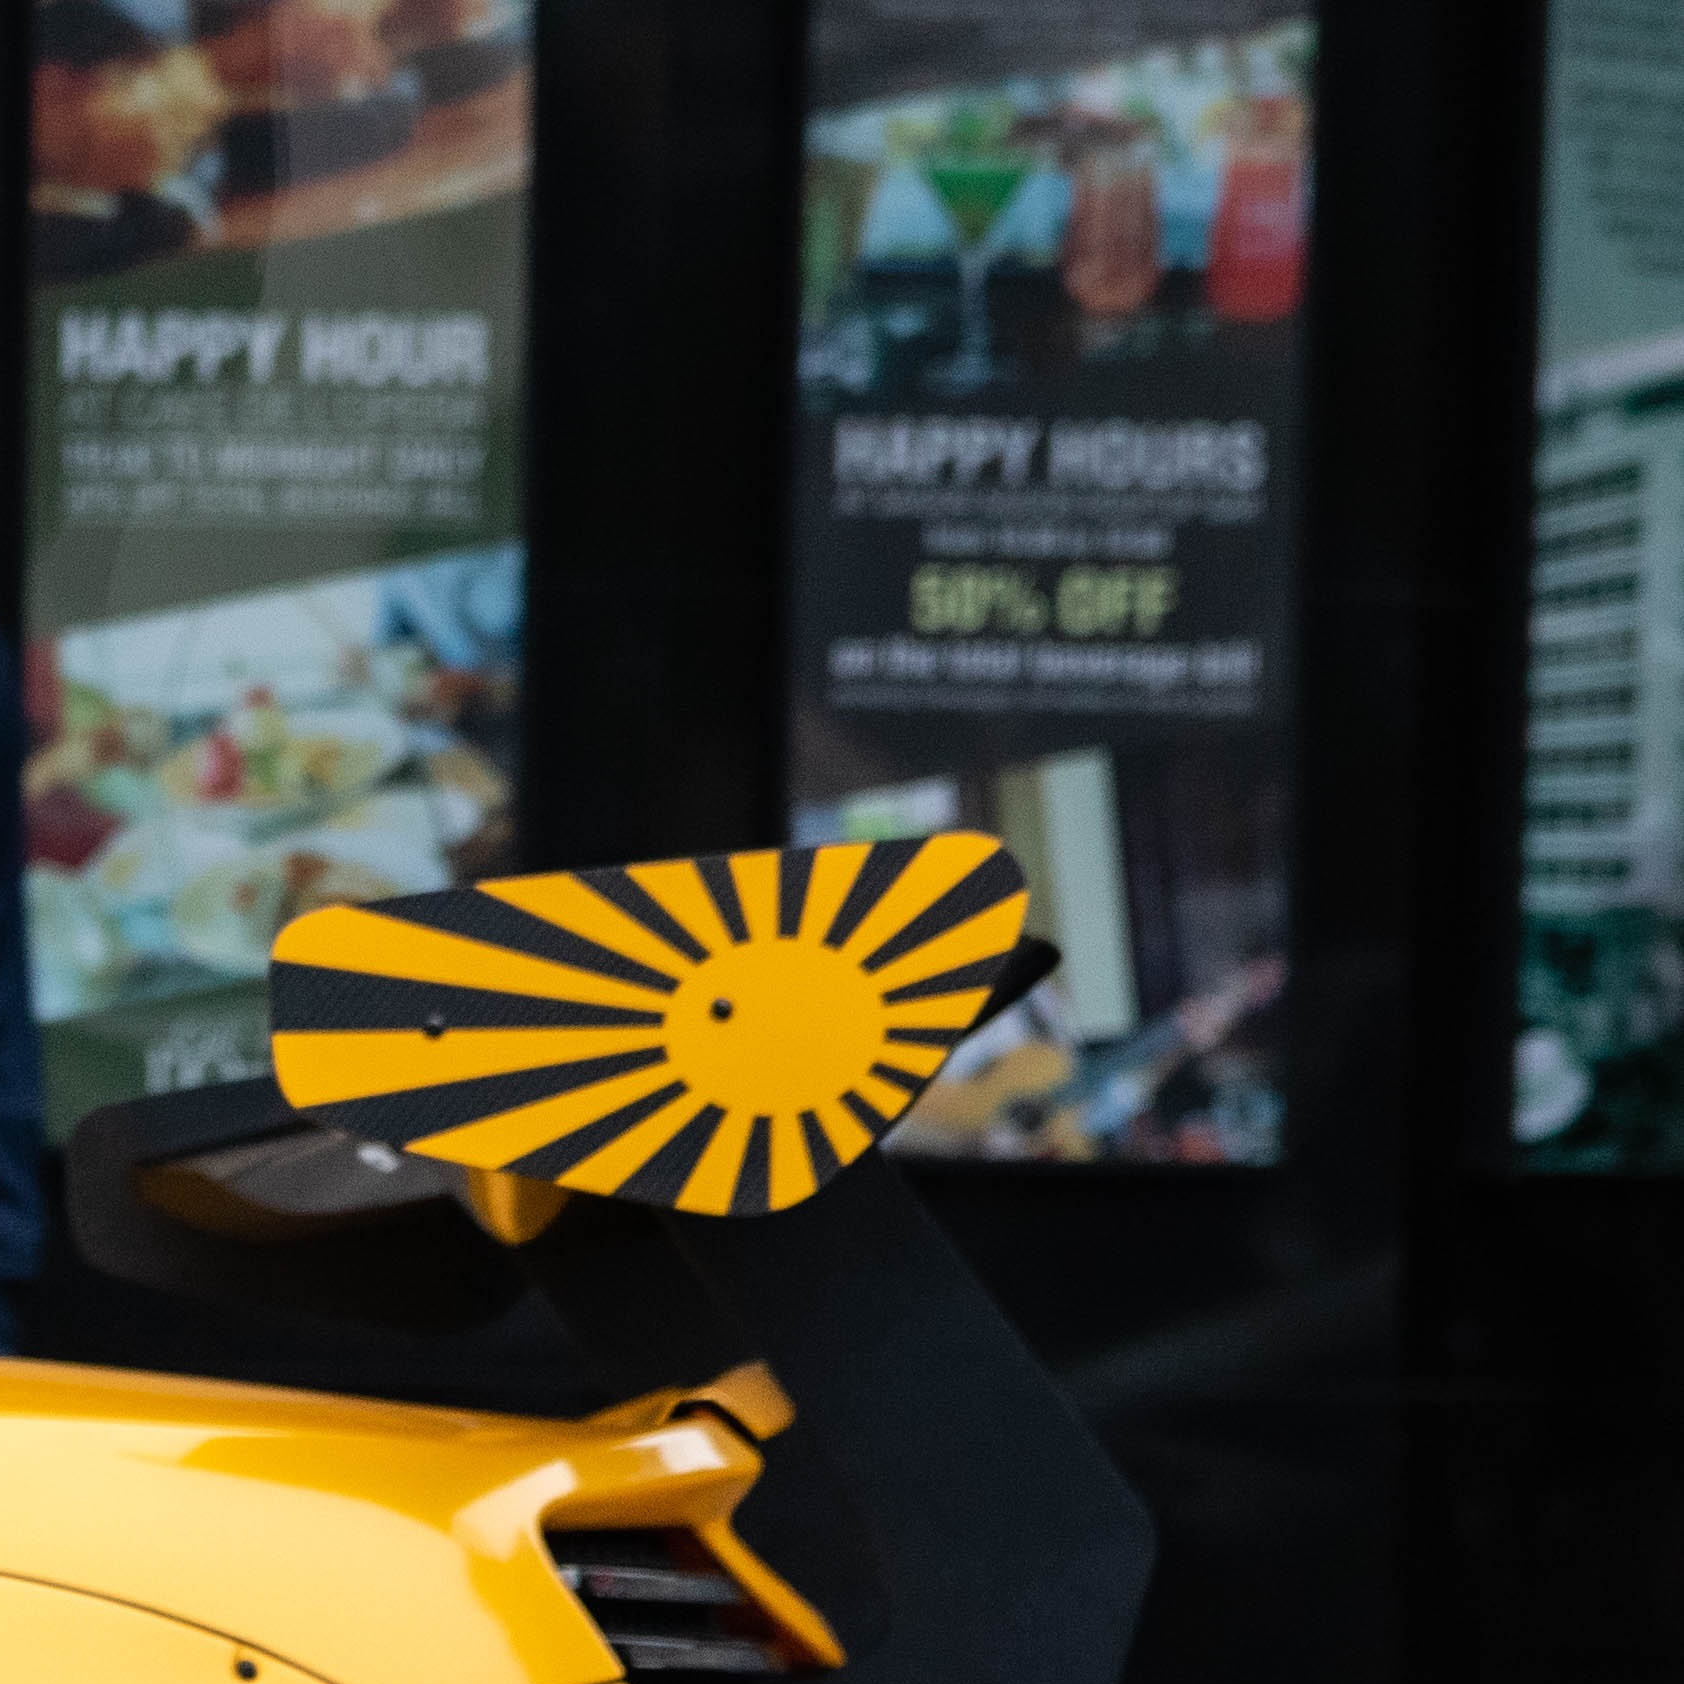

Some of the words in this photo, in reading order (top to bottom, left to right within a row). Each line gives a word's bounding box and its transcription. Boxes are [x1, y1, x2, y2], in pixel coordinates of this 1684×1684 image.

[60, 310, 288, 381] HAPPY
[301, 313, 487, 384] HOUR
[837, 418, 1038, 486] HAPPY
[1051, 421, 1264, 488] HOURS
[914, 567, 1047, 634] 50%
[1059, 566, 1177, 634] OFF
